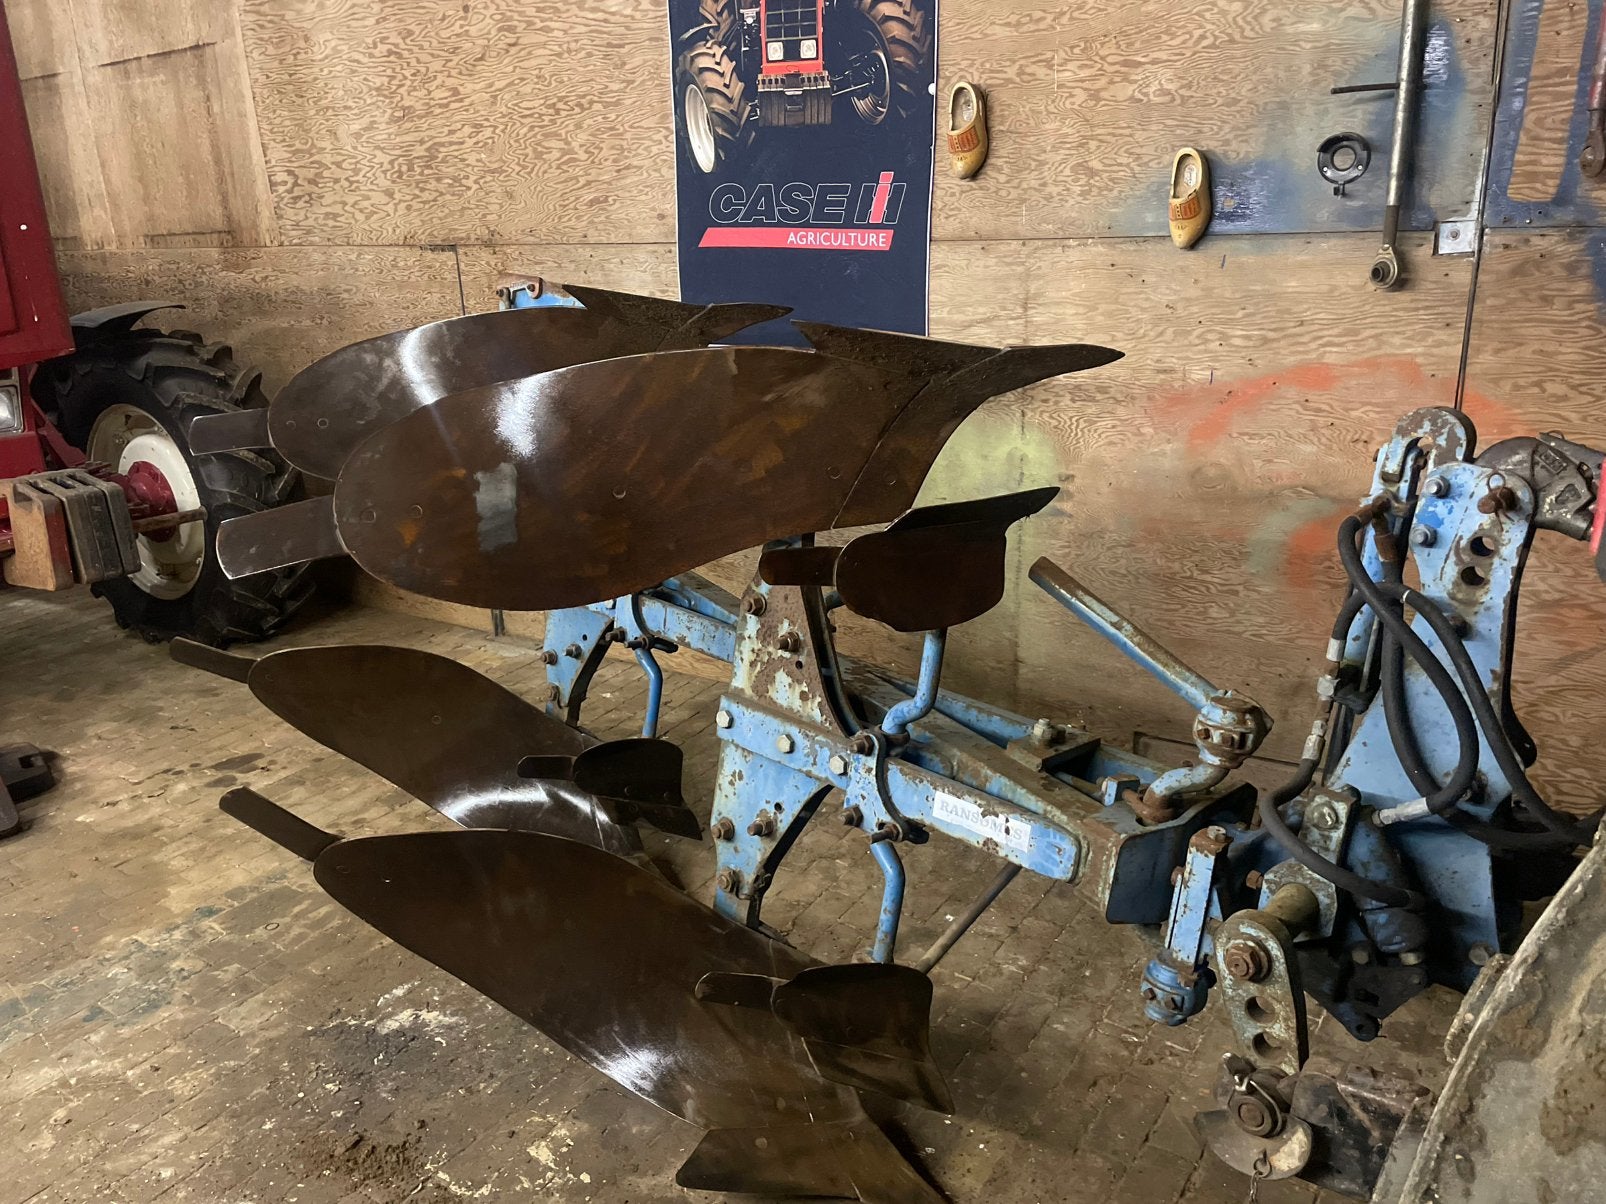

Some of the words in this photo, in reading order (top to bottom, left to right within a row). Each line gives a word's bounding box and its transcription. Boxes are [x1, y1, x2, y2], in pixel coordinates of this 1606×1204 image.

[709, 182, 851, 224] CASE
[787, 231, 887, 248] AGRICULTURE
[940, 800, 1023, 841] RANSOMS
